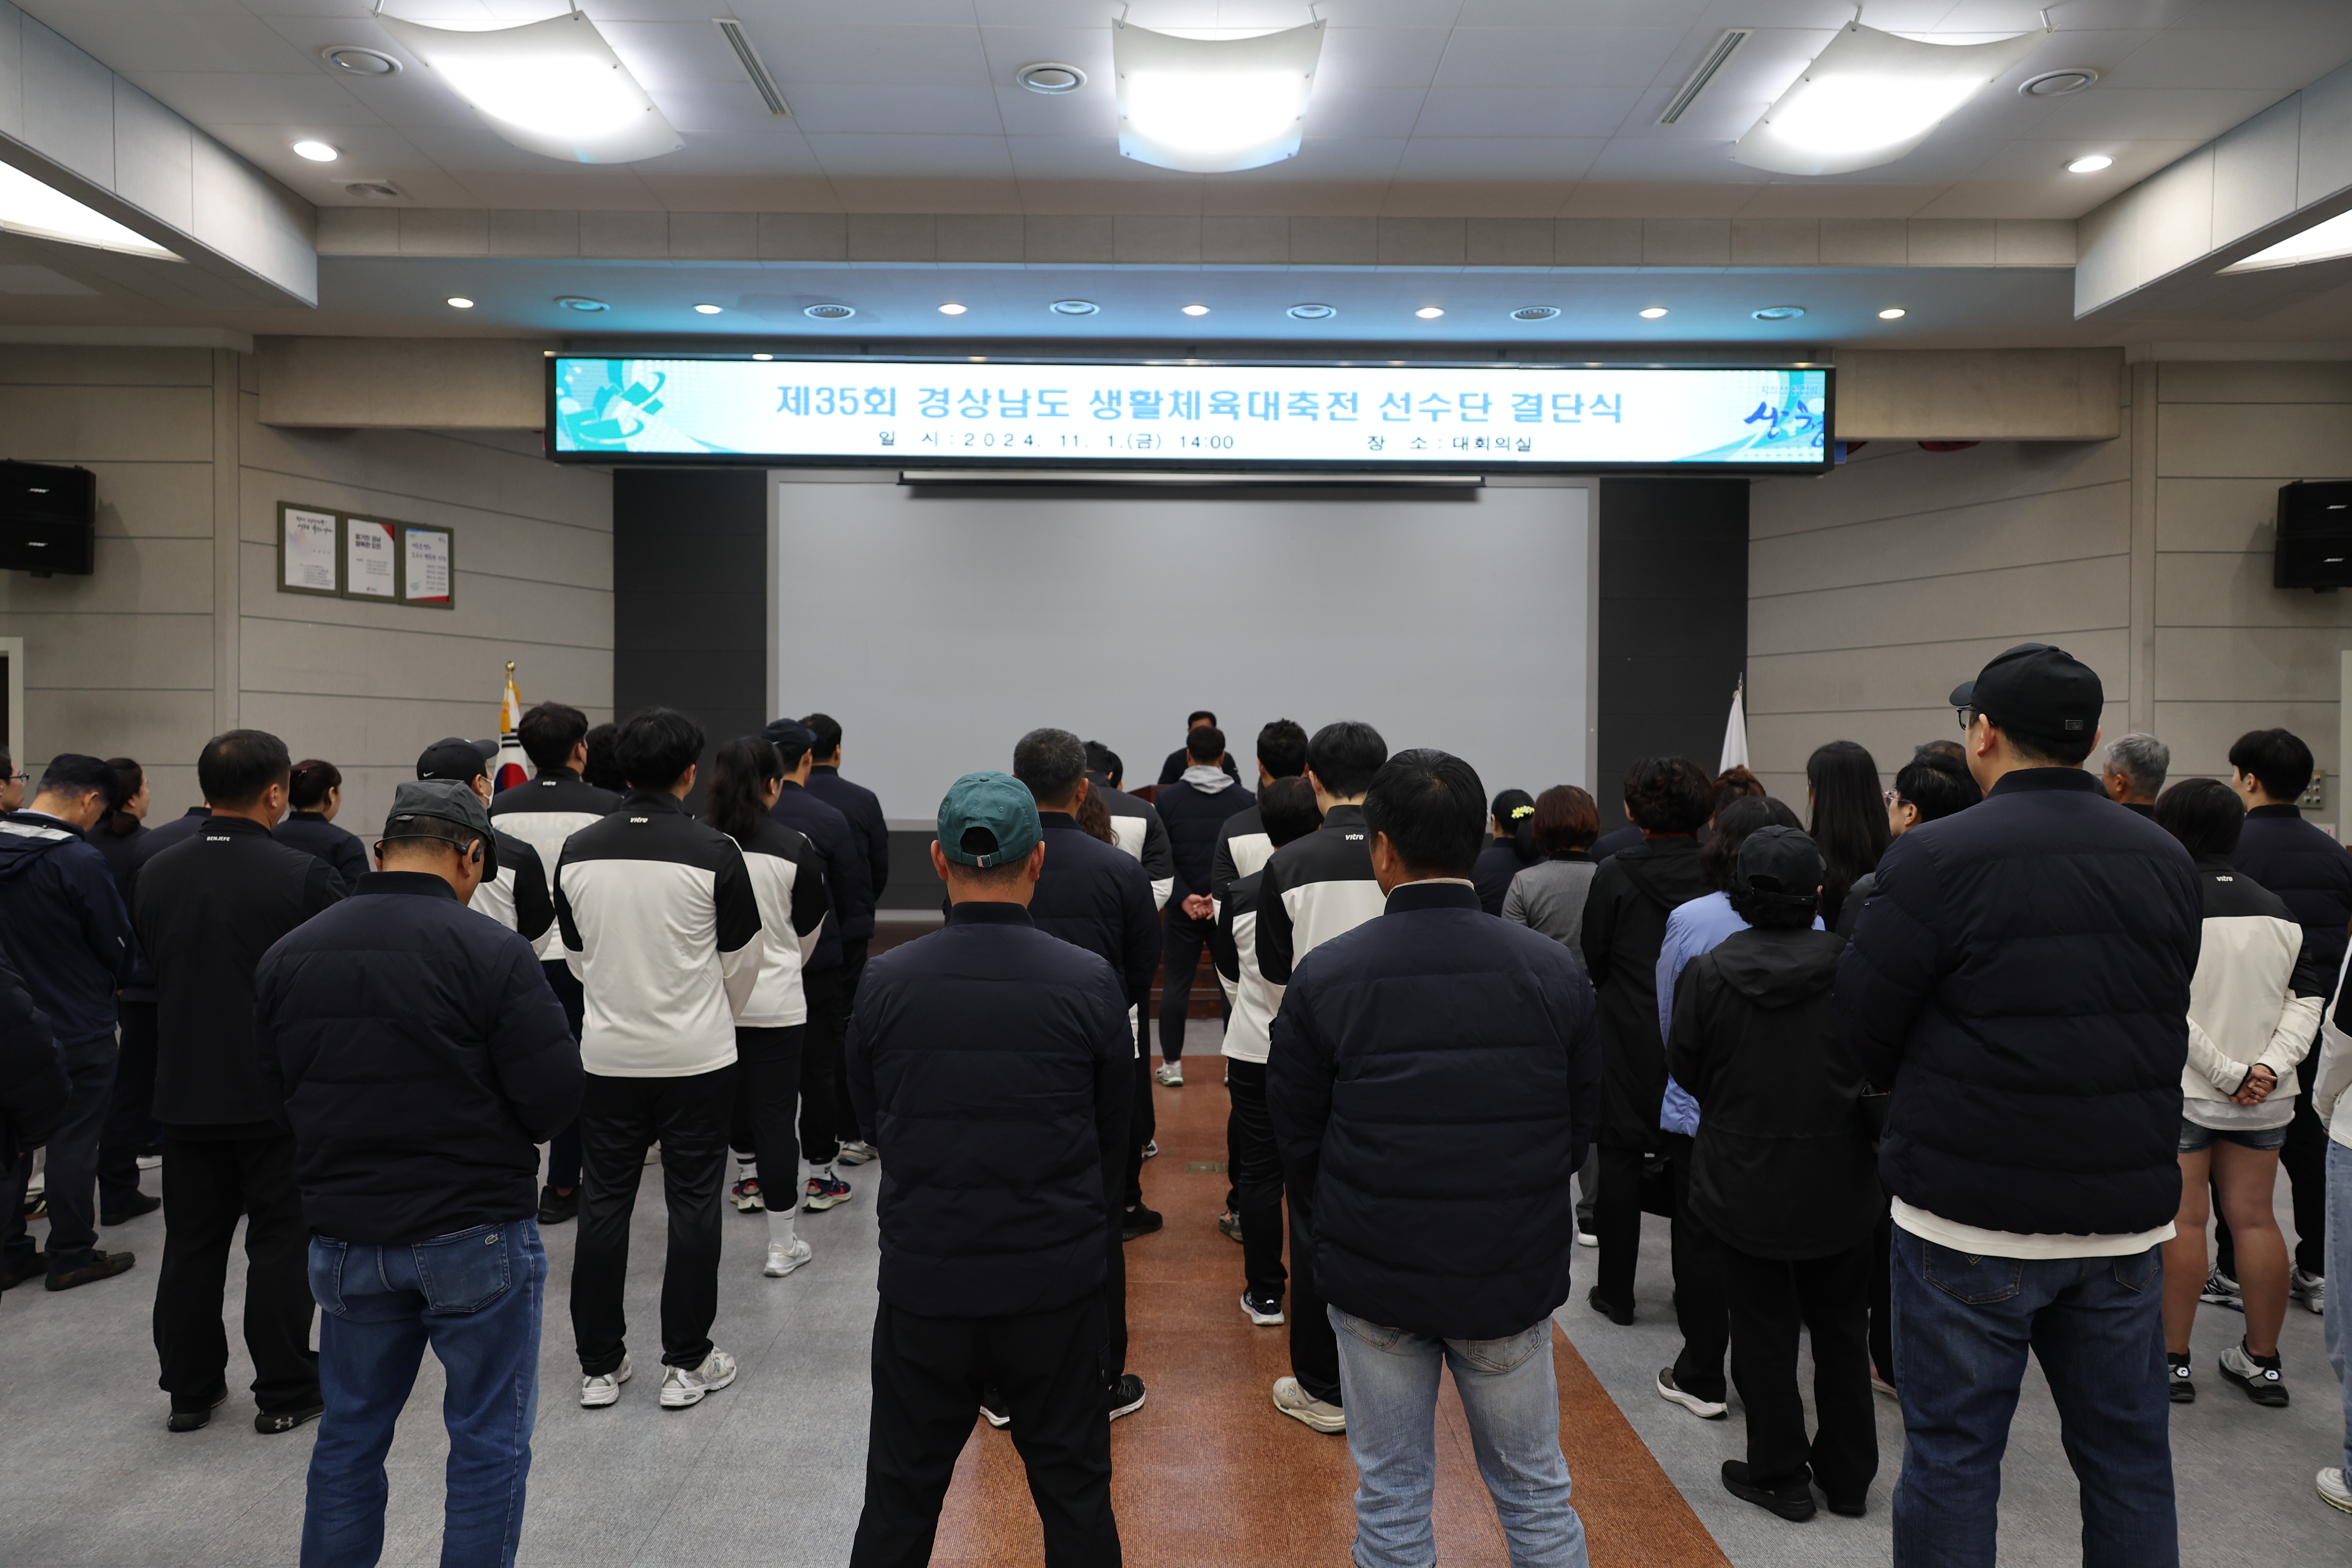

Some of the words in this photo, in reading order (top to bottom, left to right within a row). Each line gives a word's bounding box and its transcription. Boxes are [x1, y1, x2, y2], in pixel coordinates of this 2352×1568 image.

[776, 386, 896, 417] 제35회
[918, 388, 1069, 419] 경상남도
[1089, 389, 1358, 421] 생활체육대축전
[1379, 392, 1493, 422] 선수단
[1511, 393, 1621, 423] 결단식
[1180, 435, 1234, 449] 14:00
[1453, 435, 1531, 452] 대회의실
